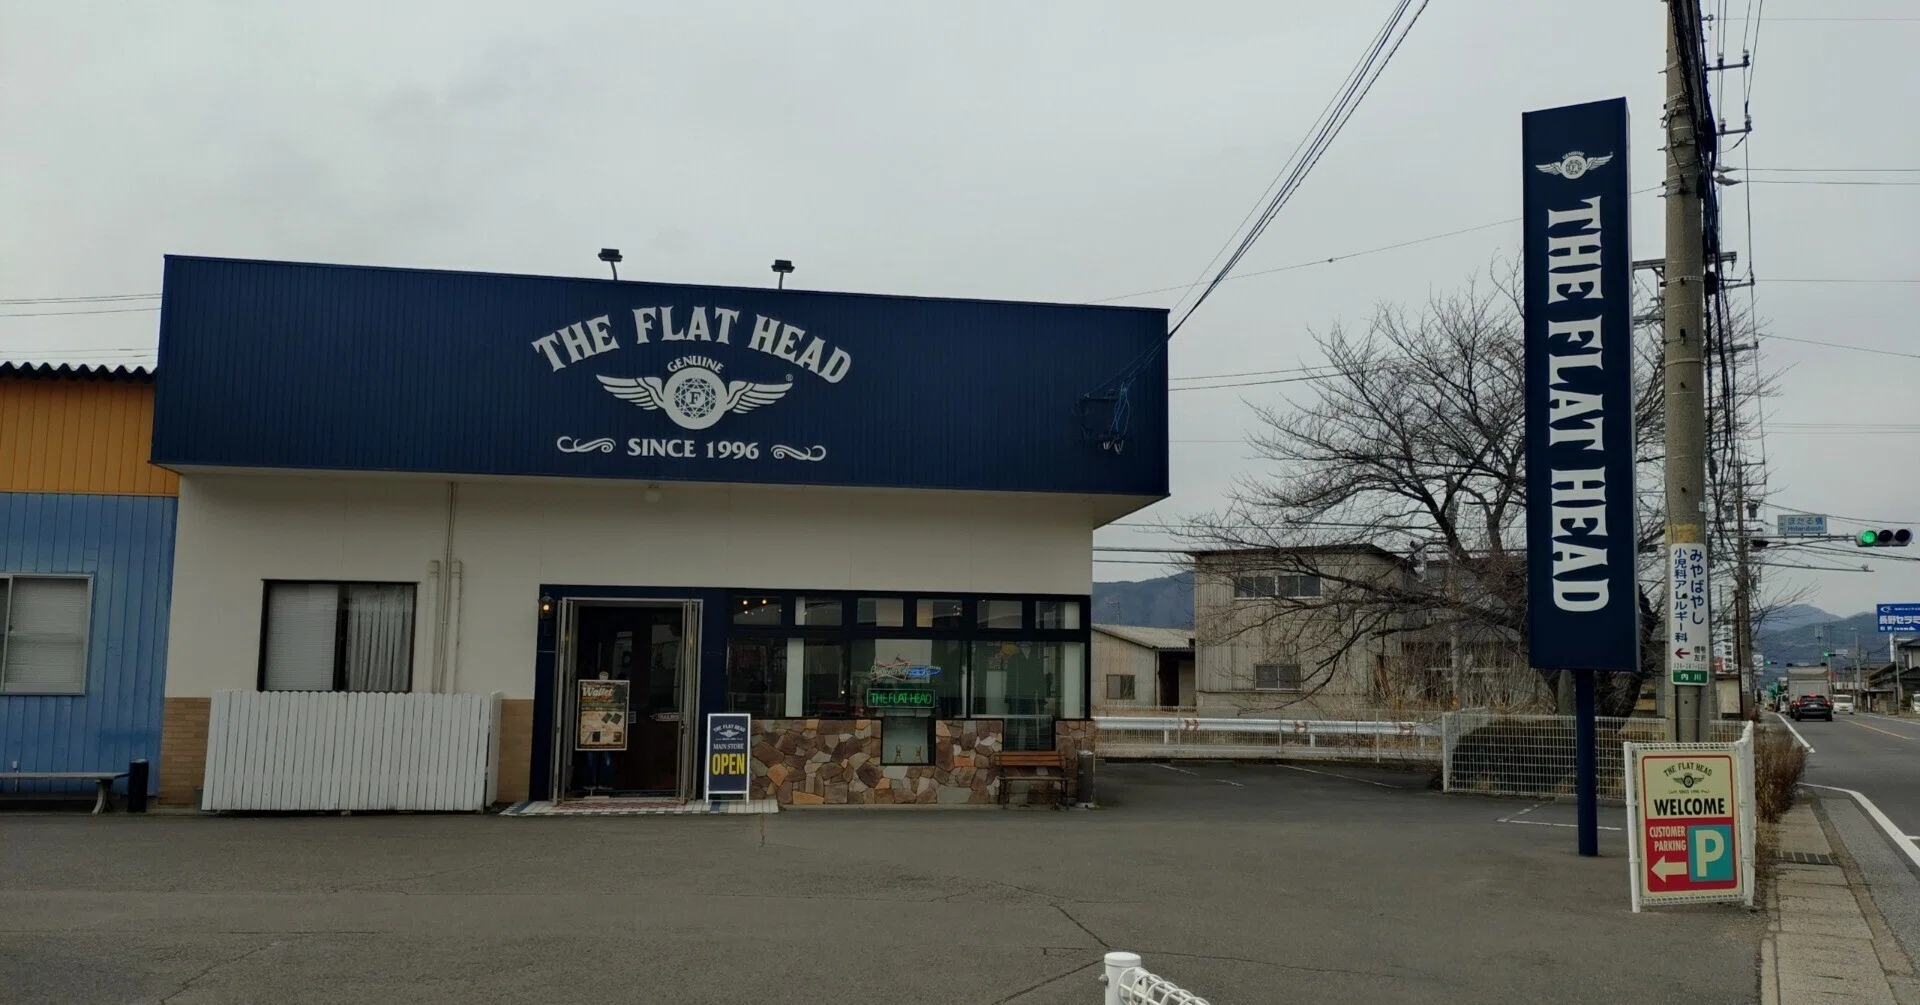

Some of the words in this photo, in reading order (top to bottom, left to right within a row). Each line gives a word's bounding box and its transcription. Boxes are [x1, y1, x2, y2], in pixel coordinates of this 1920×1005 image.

[1548, 195, 1604, 304] THE
[531, 314, 620, 372] THE
[632, 305, 740, 345] FLAT
[747, 313, 852, 384] HEAD
[667, 355, 725, 374] GENUINE
[1548, 314, 1604, 451] FLAT
[627, 438, 697, 458] SINCE
[706, 440, 760, 460] 1996
[1551, 465, 1609, 612] HEAD
[1674, 548, 1688, 643] 小児科アレルギー科
[1690, 549, 1705, 625] みやばやし
[871, 692, 888, 704] THE
[889, 692, 908, 704] FLAT
[909, 692, 932, 704] HEAD
[712, 753, 745, 775] OPEN
[1663, 764, 1677, 777] THE
[1677, 762, 1694, 771] FLAT
[1695, 762, 1713, 777] HEAD
[1654, 798, 1725, 816] WELCOME
[1649, 826, 1686, 838] CUSTOMER
[1654, 840, 1687, 852] PARKING
[1695, 829, 1725, 877] P
